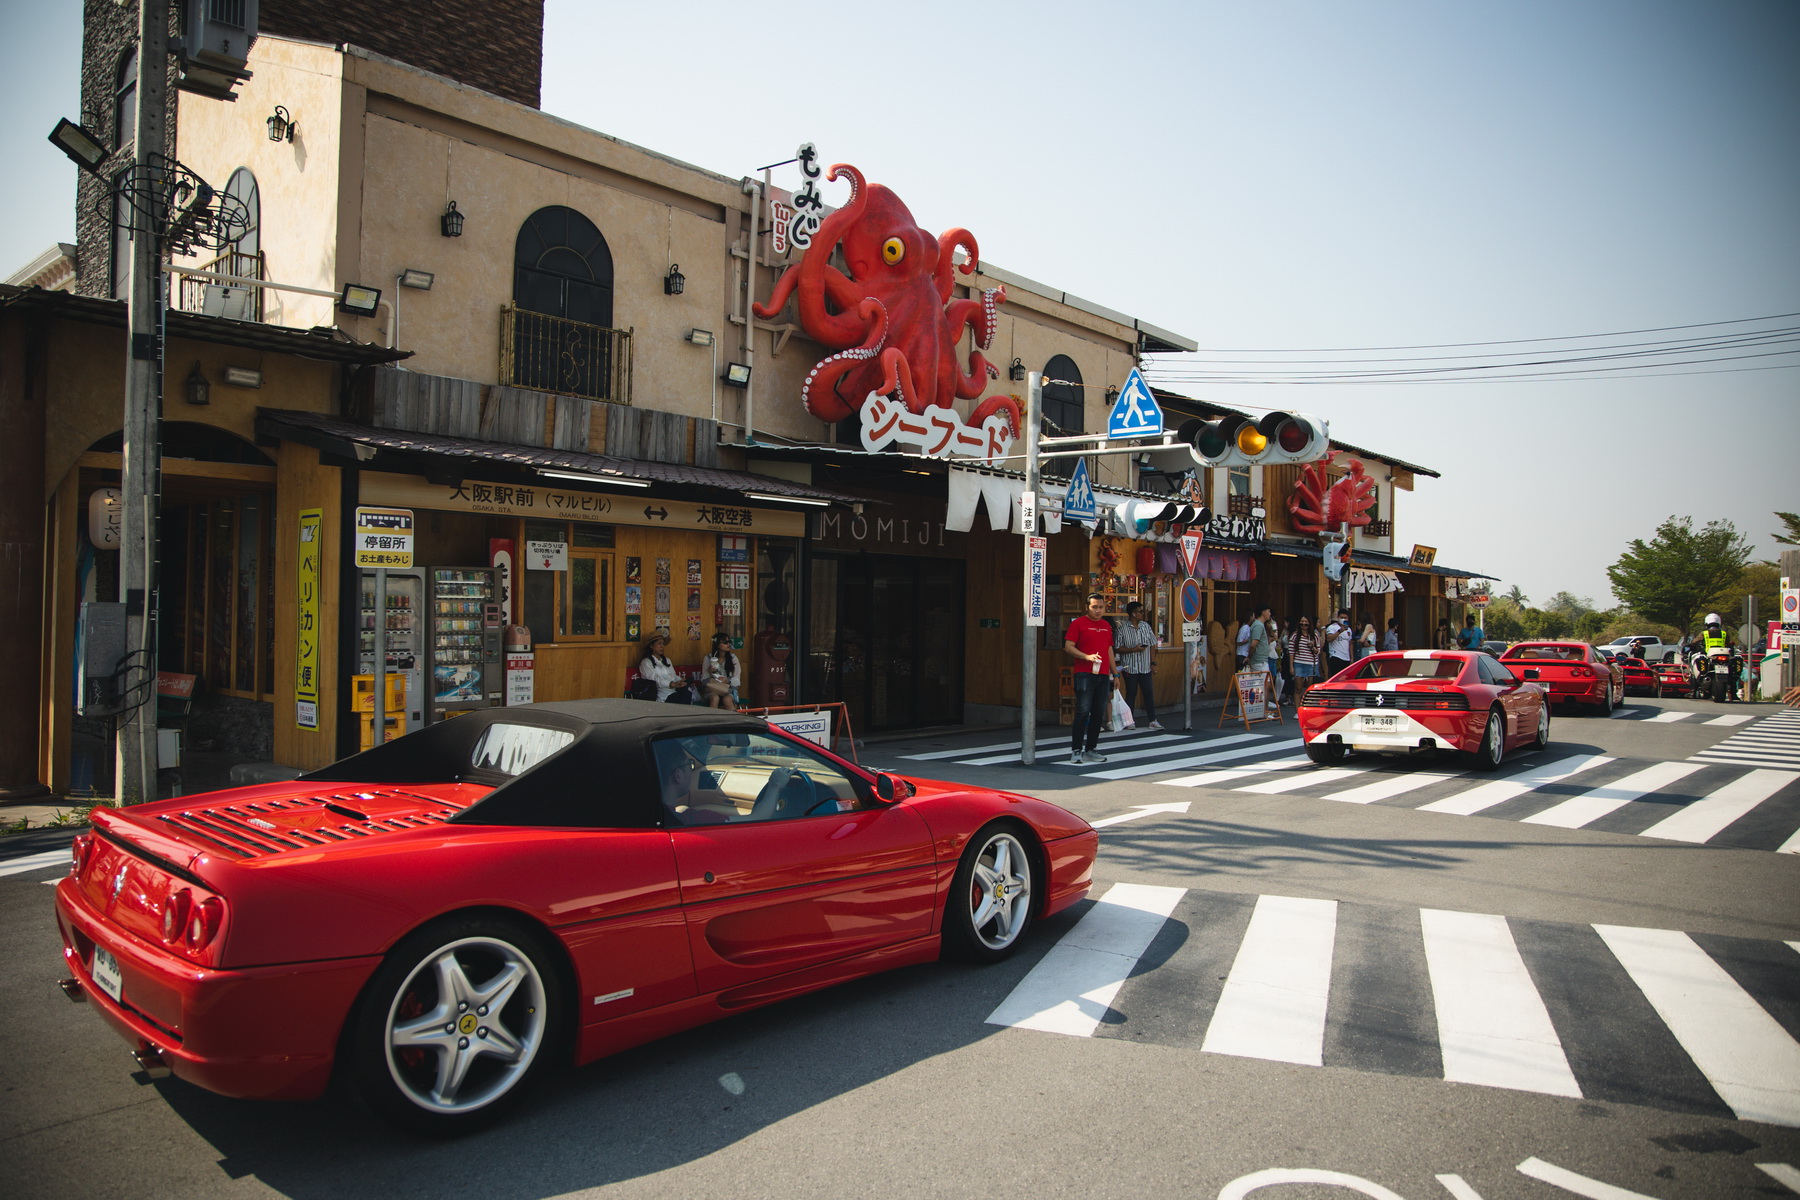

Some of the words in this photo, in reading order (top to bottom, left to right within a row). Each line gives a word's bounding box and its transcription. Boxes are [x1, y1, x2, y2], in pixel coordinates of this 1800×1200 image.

[787, 146, 822, 245] もみじ
[869, 400, 1008, 465] シーフード
[450, 484, 535, 508] 大阪駅前
[473, 504, 495, 512] OSAKA
[498, 506, 514, 514] STA.
[697, 505, 752, 527] 大阪空港
[1024, 507, 1033, 529] 注意
[823, 511, 945, 546] MOMIJI
[365, 536, 405, 549] 停留所
[1185, 540, 1196, 550] 徐行
[360, 555, 409, 564] お土産もみじ
[1032, 551, 1043, 618] 歩行者に注意
[302, 555, 313, 687] ペリカン便
[1381, 718, 1393, 726] 348
